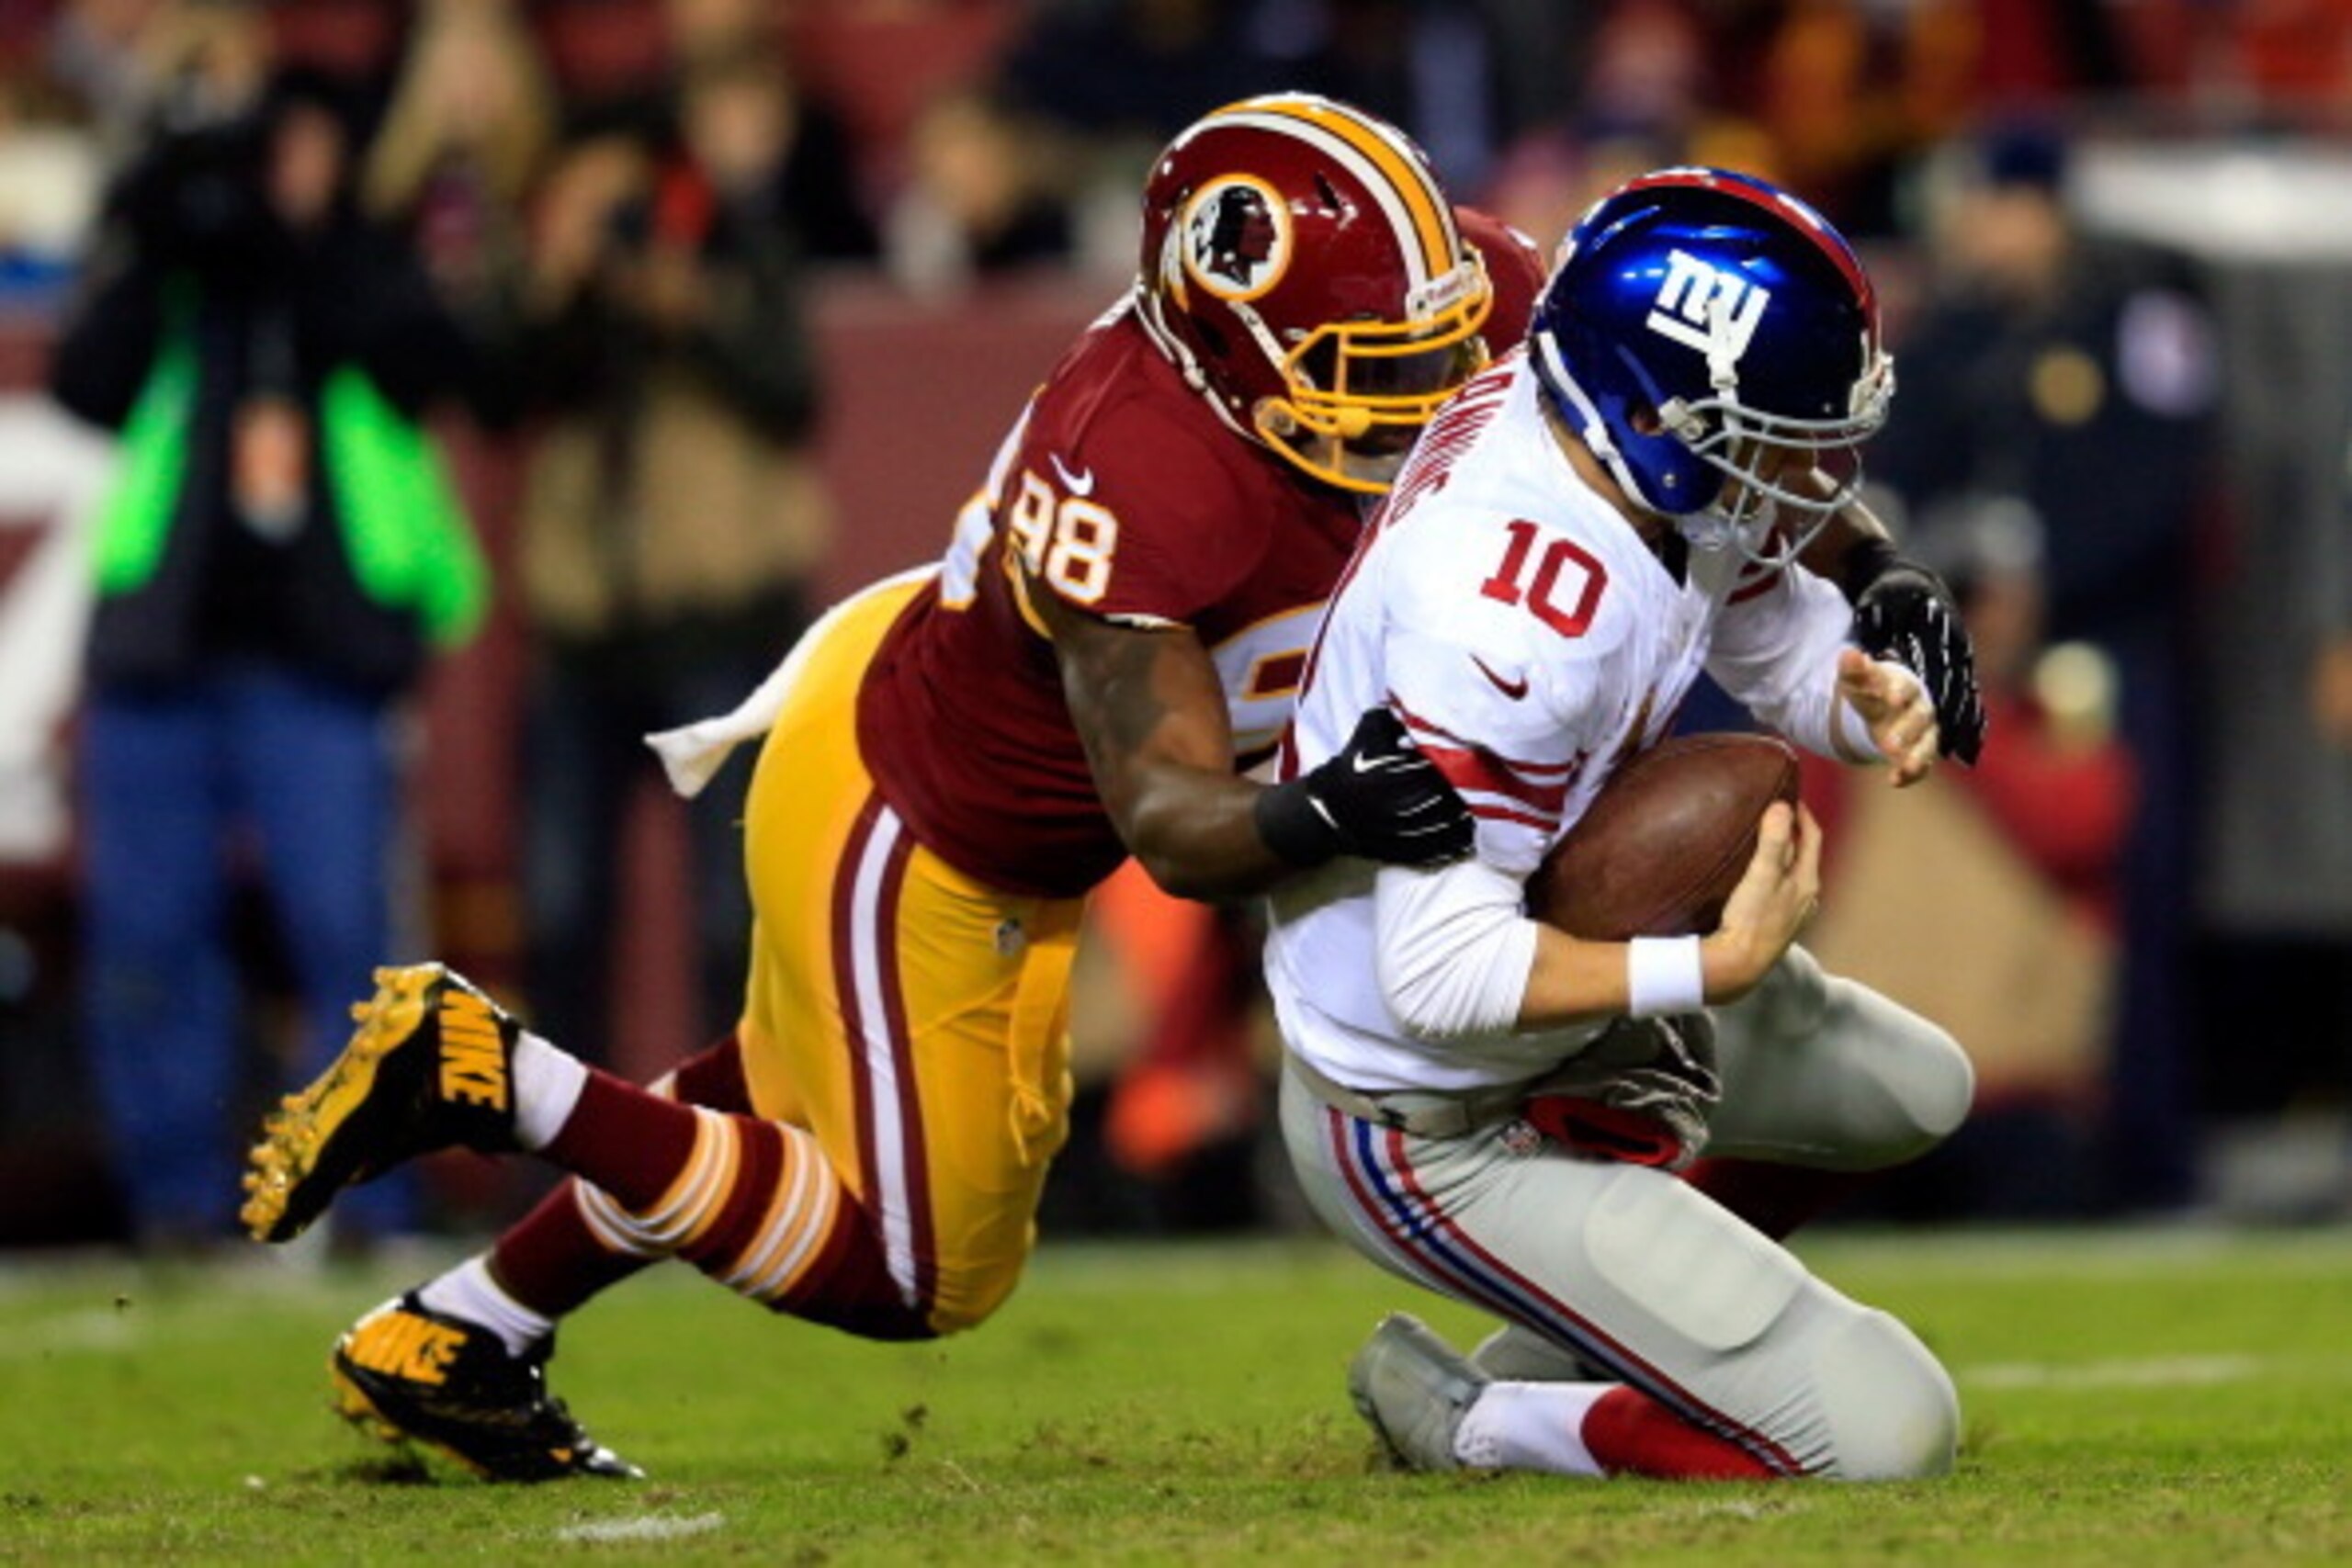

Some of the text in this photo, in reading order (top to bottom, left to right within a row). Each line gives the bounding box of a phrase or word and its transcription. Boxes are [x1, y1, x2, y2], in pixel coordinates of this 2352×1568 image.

[1011, 467, 1119, 607] 98
[1480, 519, 1608, 638] 10
[438, 988, 507, 1111] NIKE
[342, 1311, 467, 1384] NIKE
